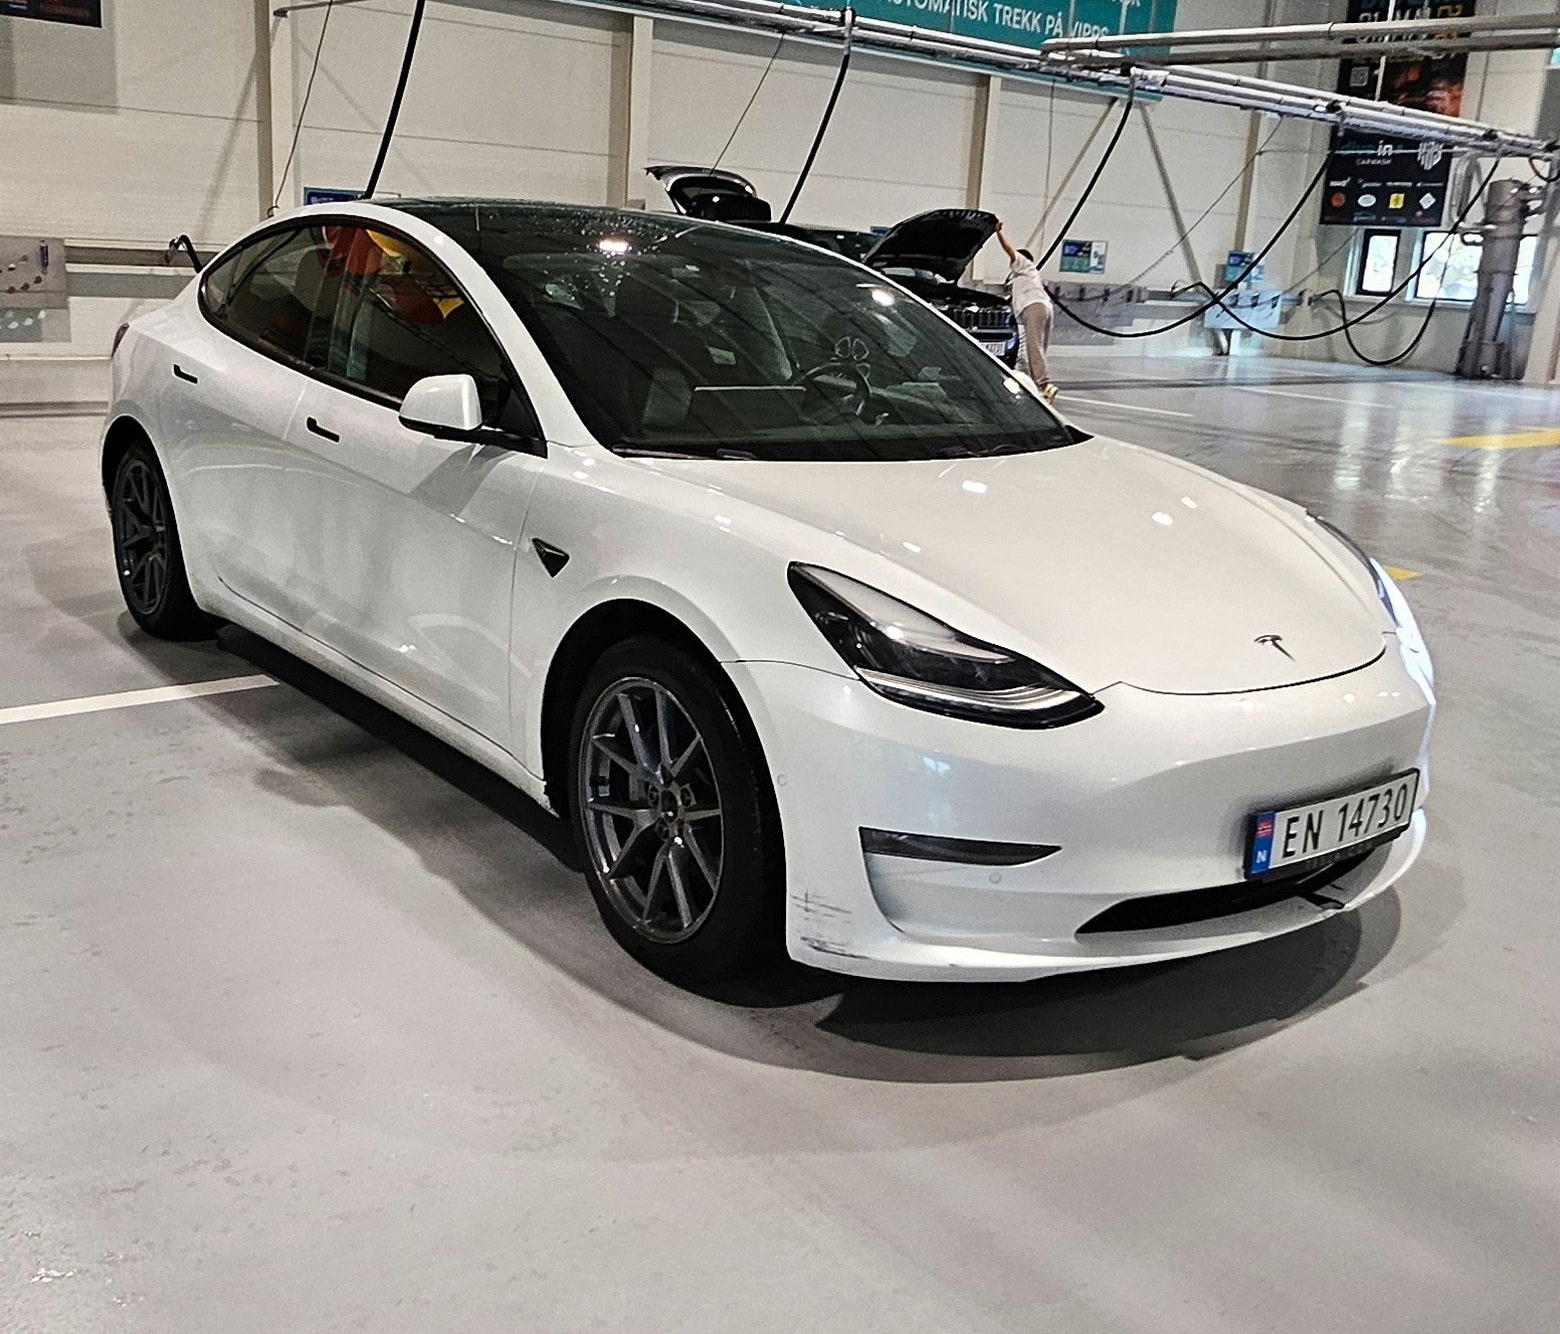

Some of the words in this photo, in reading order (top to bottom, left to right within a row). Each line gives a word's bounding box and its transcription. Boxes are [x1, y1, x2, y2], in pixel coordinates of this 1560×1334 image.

[993, 3, 1041, 33] TREKK
[1045, 11, 1064, 37] PÅ
[1282, 810, 1324, 859] EN
[1338, 783, 1408, 843] 14730
[1255, 850, 1267, 864] N
